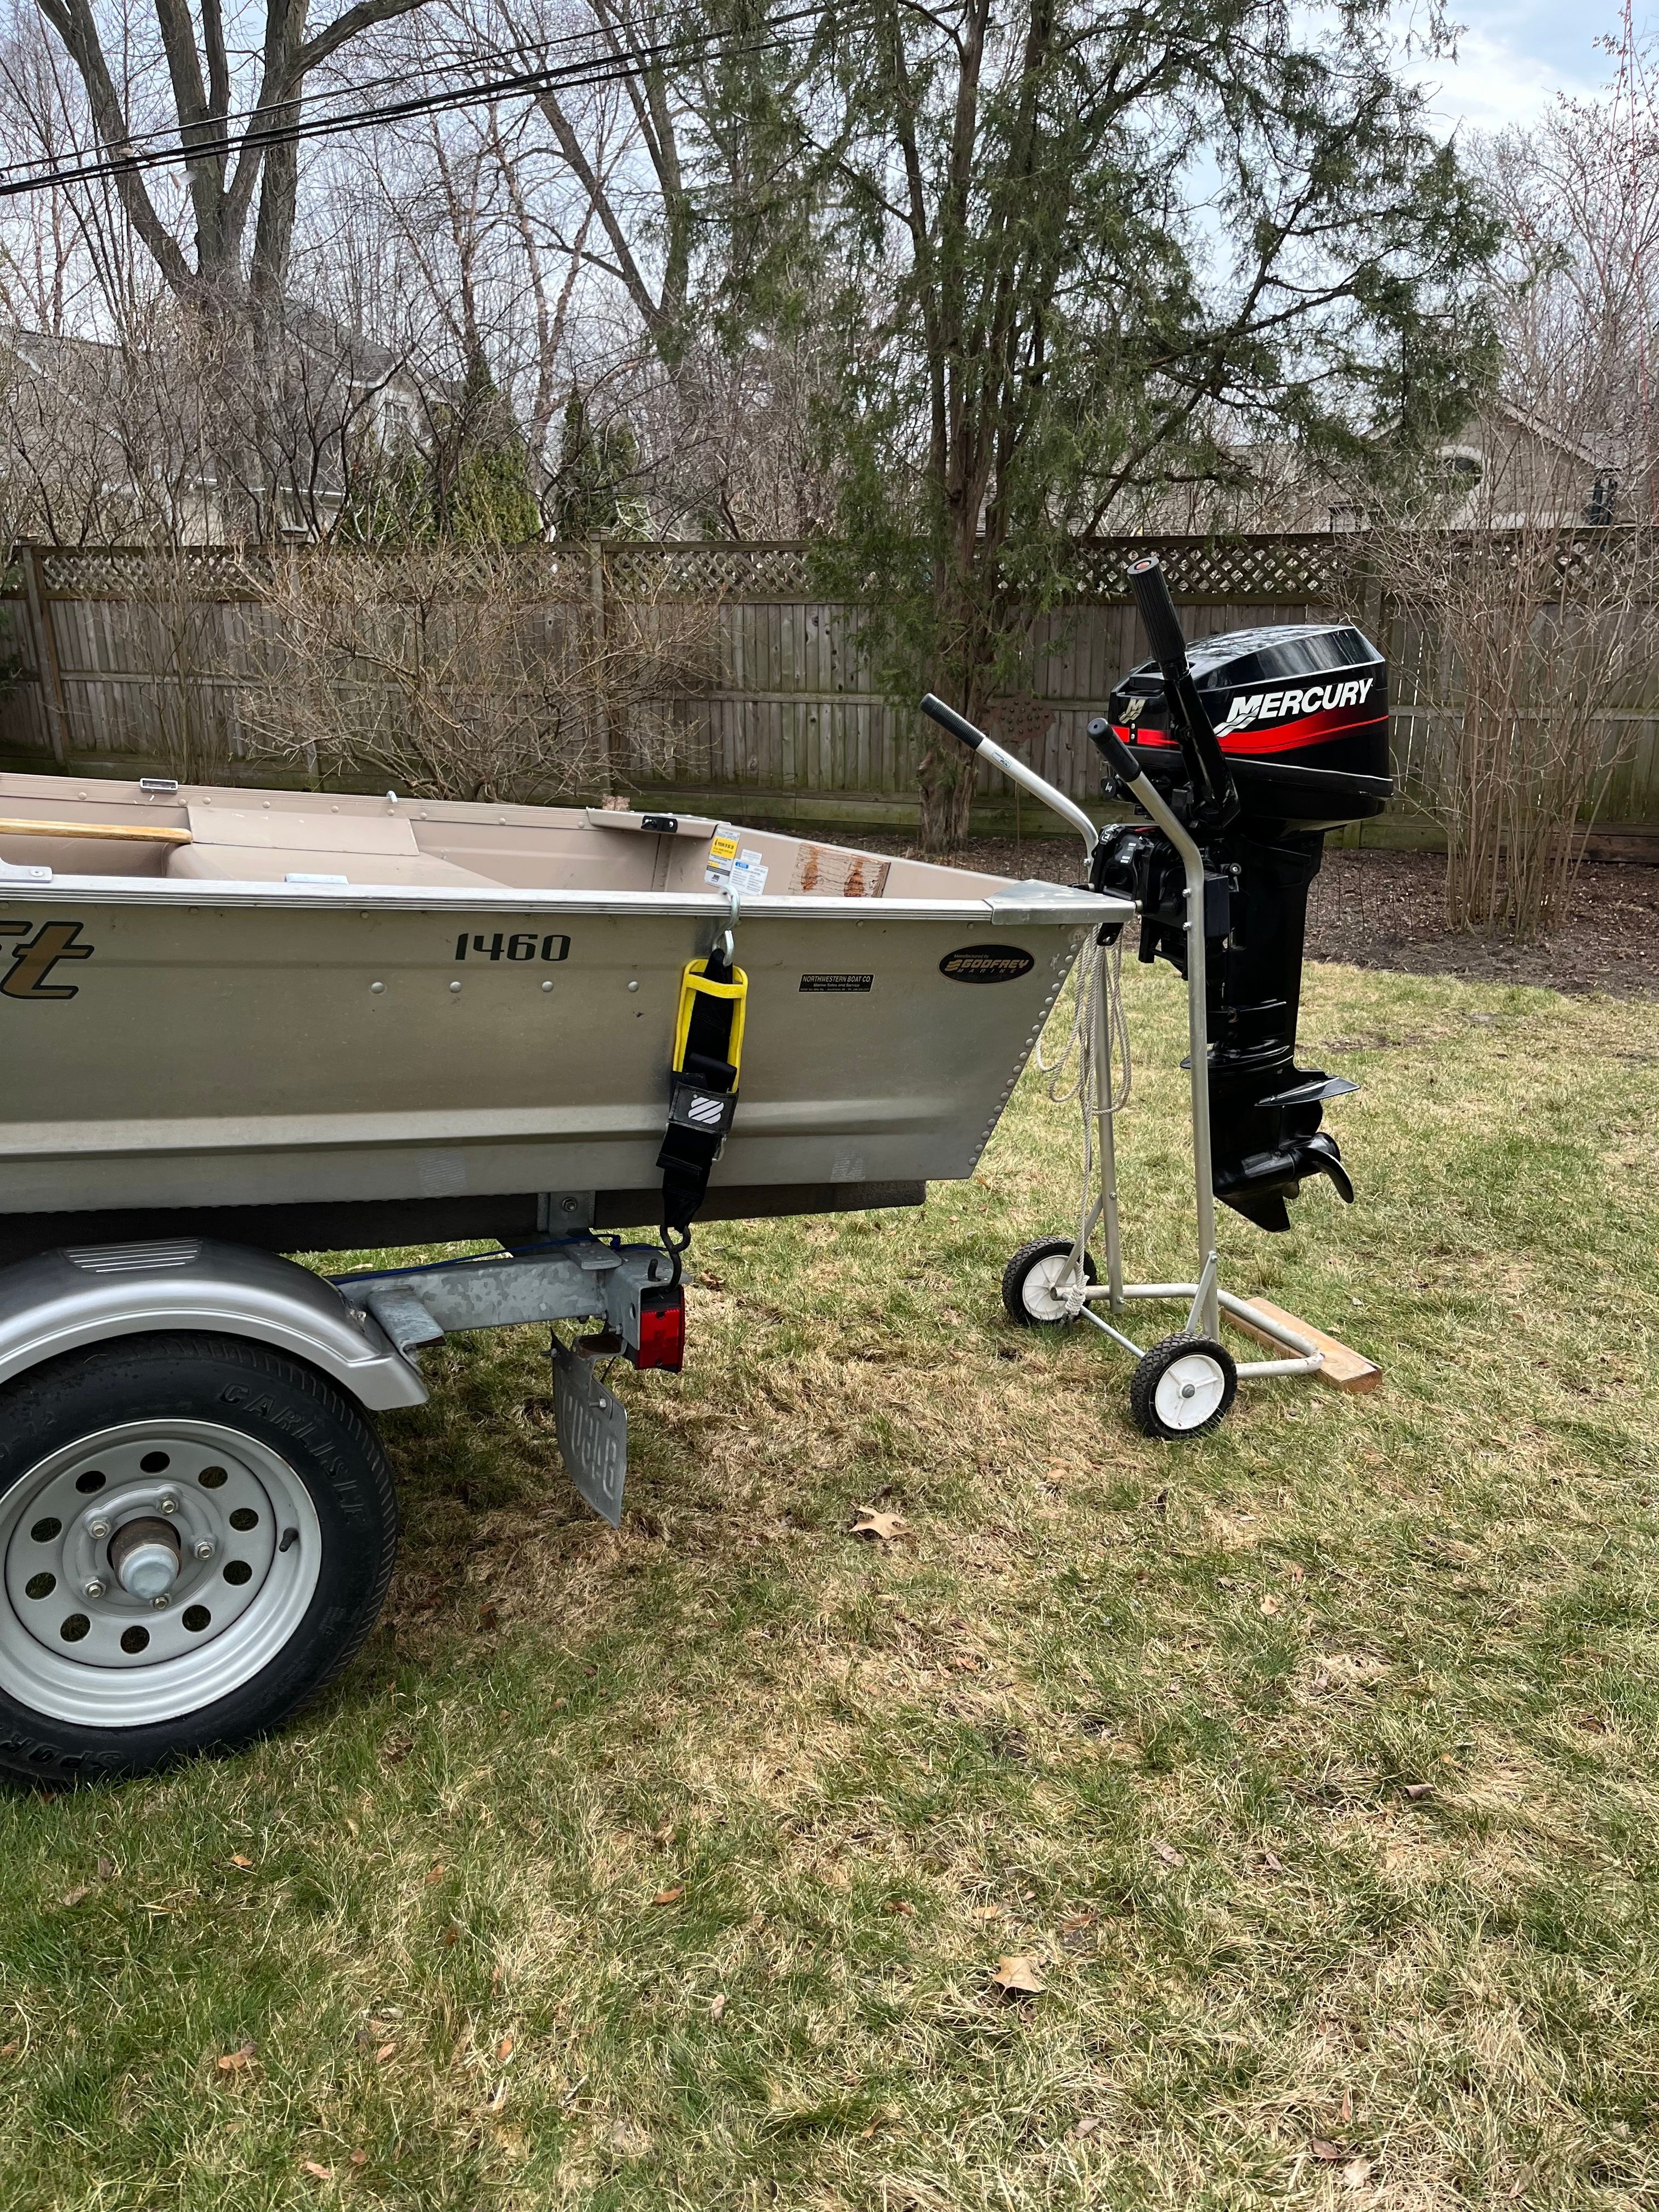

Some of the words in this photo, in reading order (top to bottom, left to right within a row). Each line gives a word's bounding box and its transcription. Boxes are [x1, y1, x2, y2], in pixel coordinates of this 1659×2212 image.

[1226, 678, 1373, 723] MERCURY
[455, 933, 571, 961] 1460
[961, 960, 1029, 968] GODFREY
[221, 1383, 365, 1525] CARLISLE
